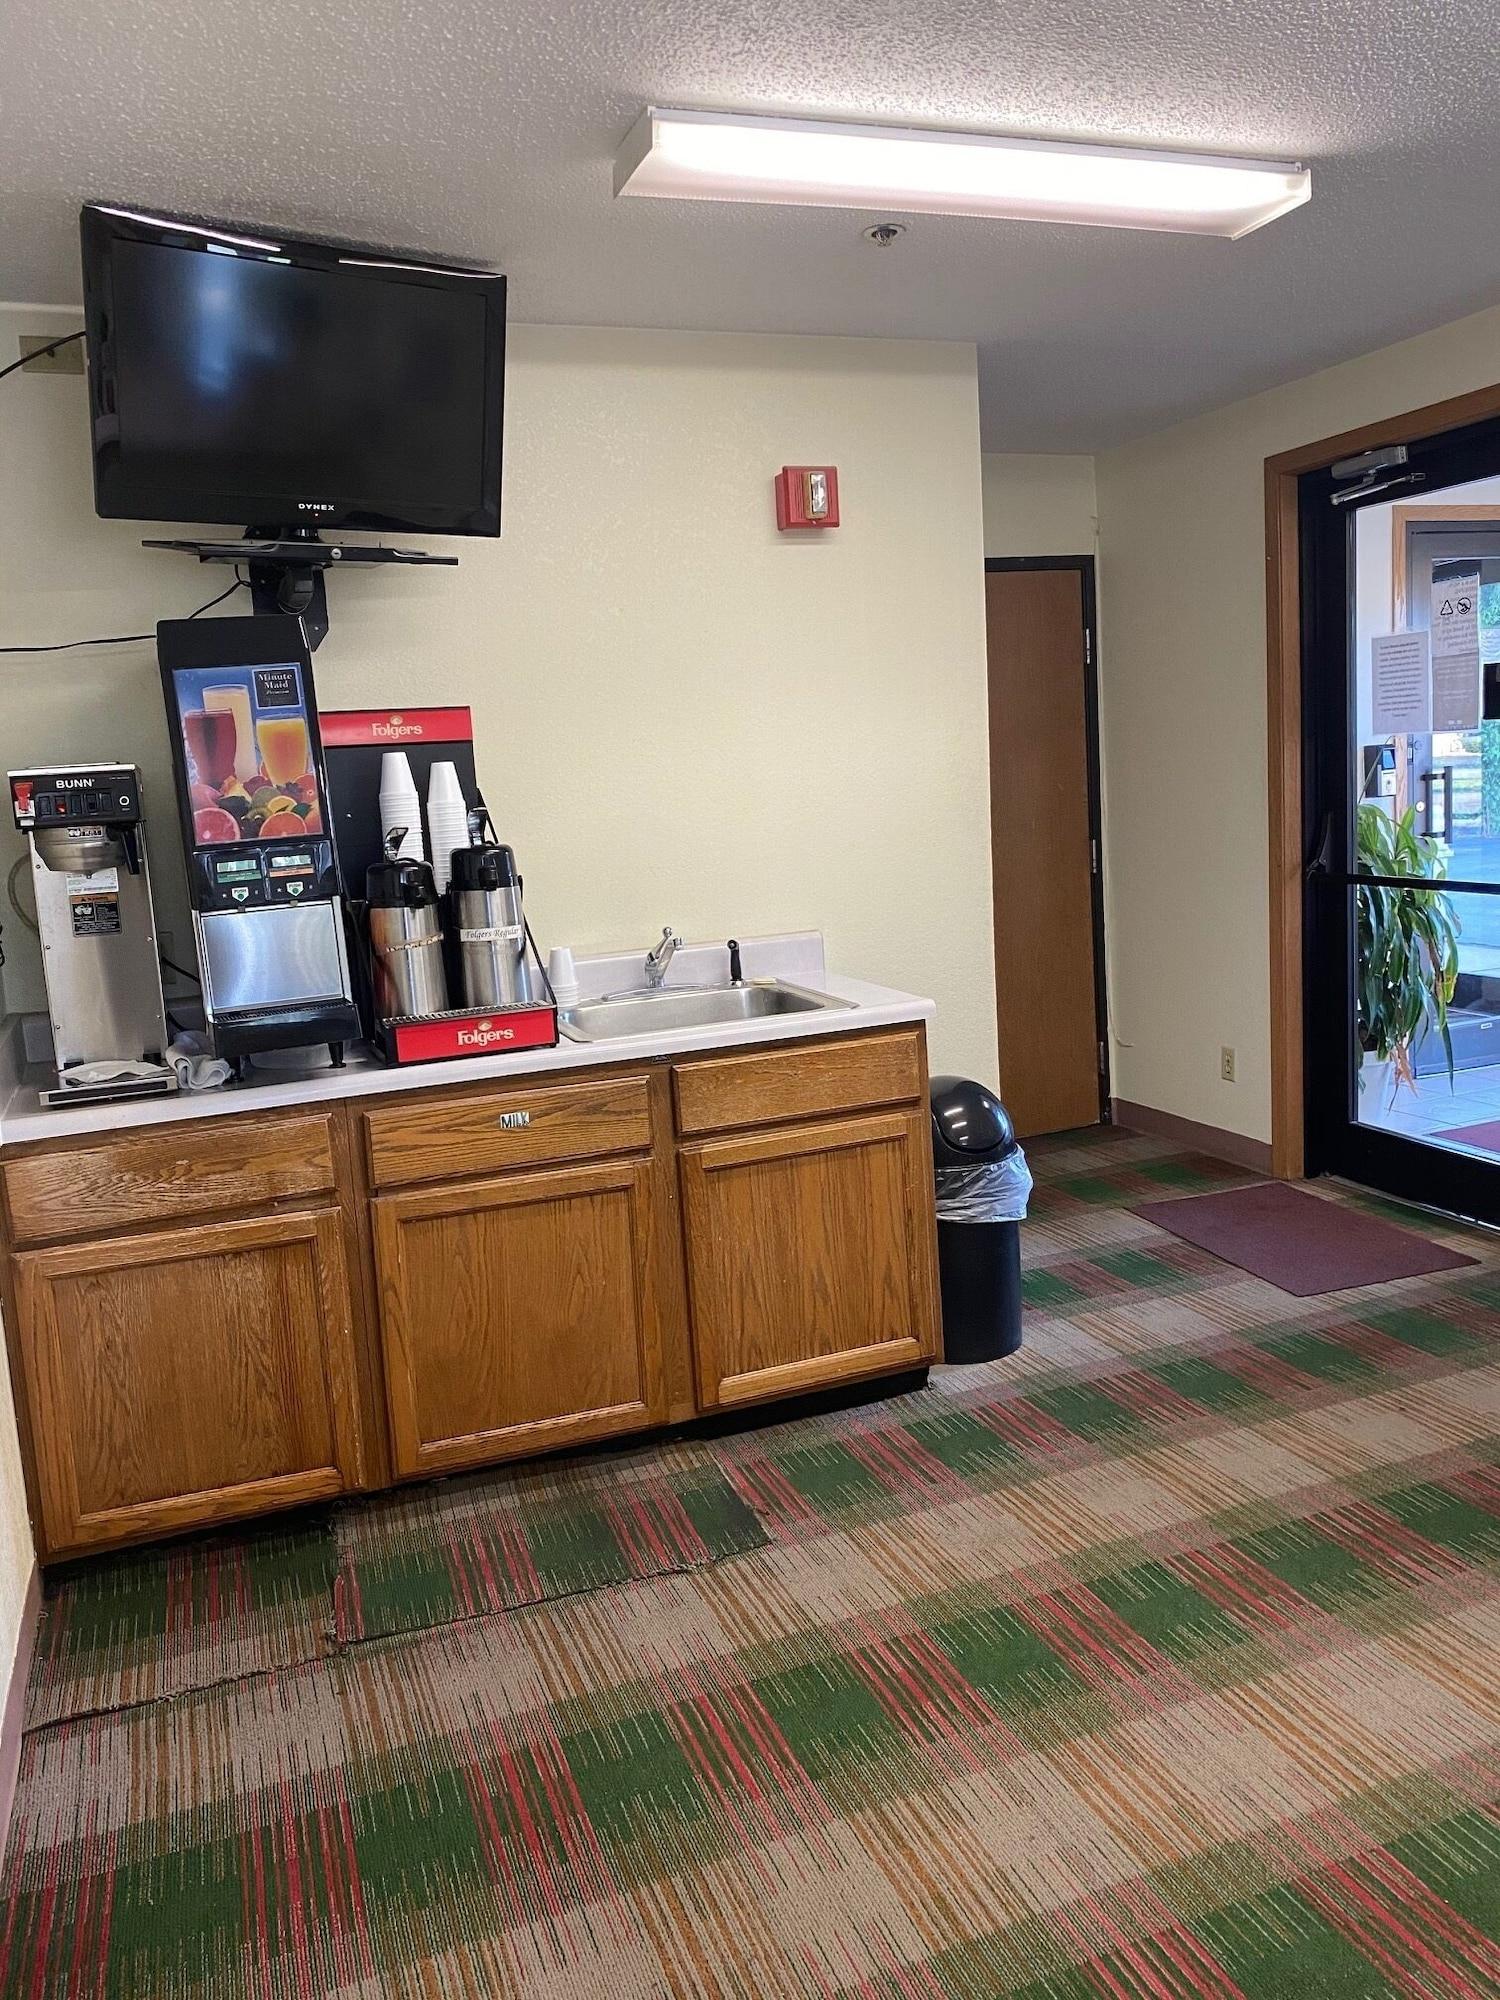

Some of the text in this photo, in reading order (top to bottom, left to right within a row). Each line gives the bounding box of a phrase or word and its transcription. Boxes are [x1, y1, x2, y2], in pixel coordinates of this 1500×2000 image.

[298, 503, 335, 511] DYNEX
[258, 673, 293, 681] Minute
[264, 680, 289, 689] Maid
[371, 723, 423, 739] Folgers
[55, 779, 93, 789] BUNN
[464, 926, 519, 940] Folgers Regular
[457, 1028, 514, 1047] Folgers
[501, 1112, 530, 1129] MILK
